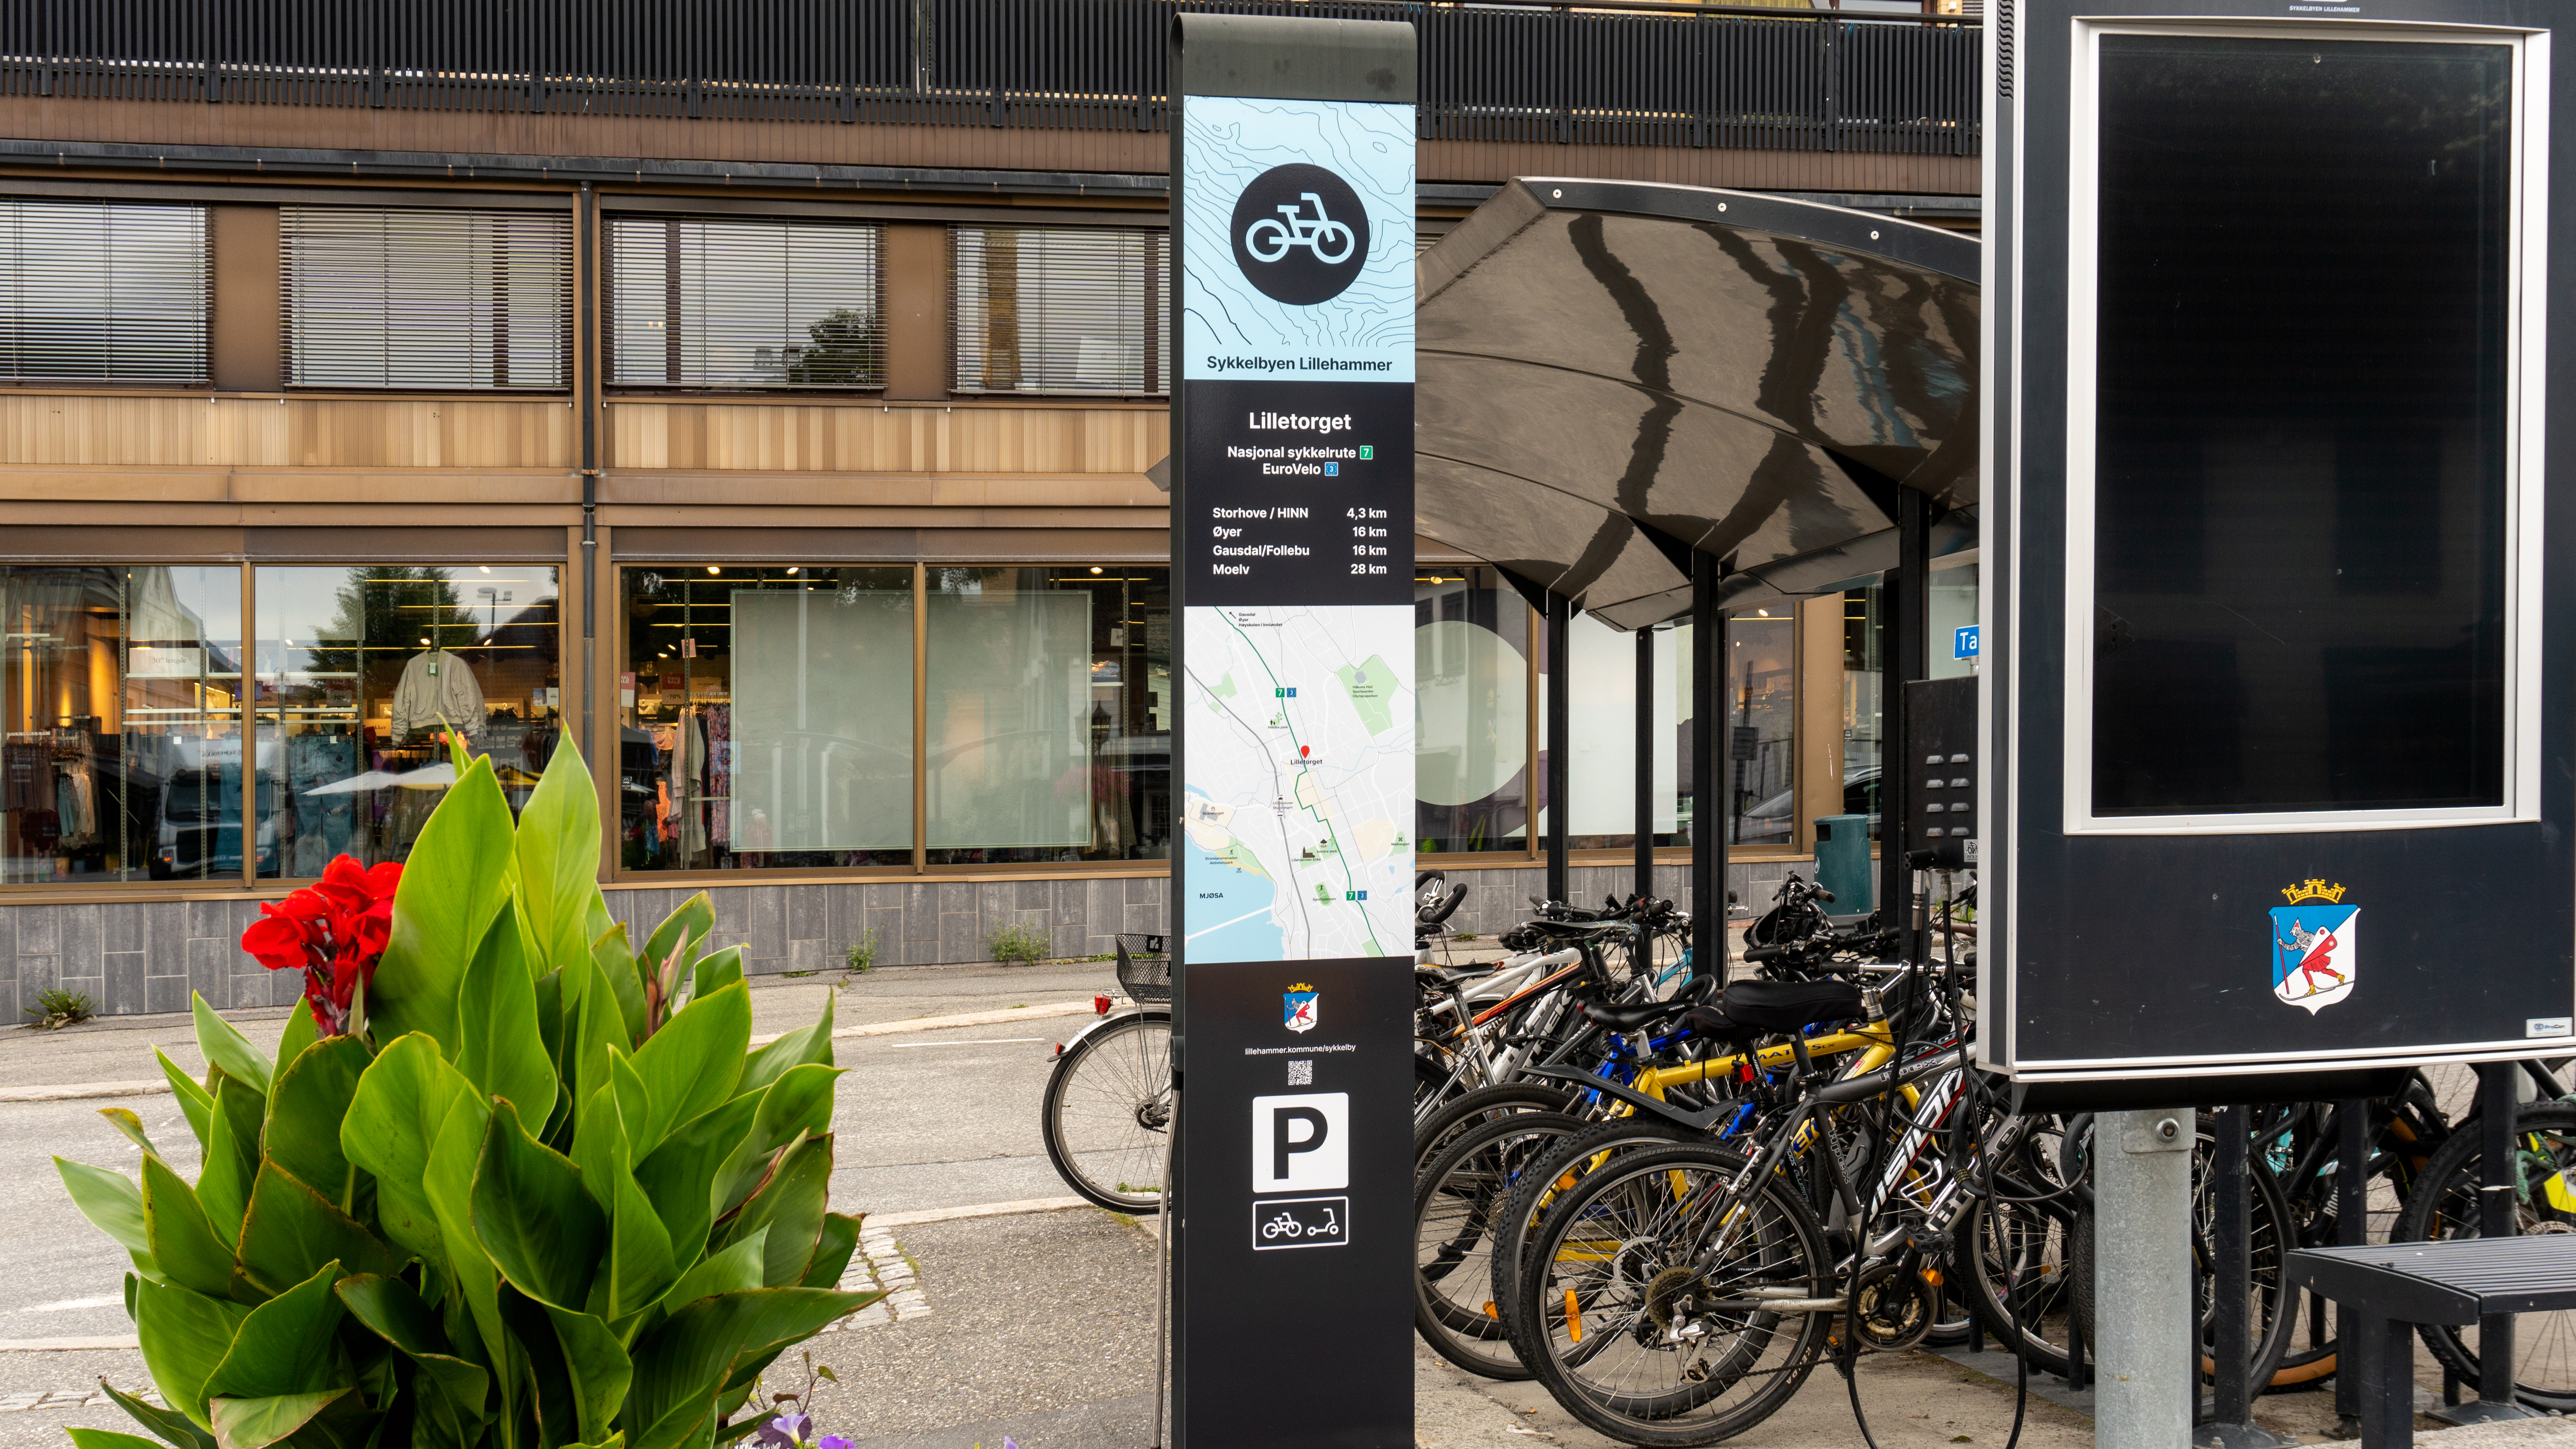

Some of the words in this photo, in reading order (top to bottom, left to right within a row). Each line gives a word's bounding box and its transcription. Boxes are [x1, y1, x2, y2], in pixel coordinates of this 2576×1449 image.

[1207, 356, 1295, 372] Sykkelbyen
[1300, 357, 1392, 371] Lillehammer
[1249, 412, 1351, 433] Lilletorget
[1228, 446, 1284, 460] Nasjonal
[1288, 447, 1356, 460] sykkelrute
[1363, 448, 1369, 457] 7
[1263, 464, 1321, 475] EuroVelo
[1213, 508, 1267, 518] Storhove
[1270, 507, 1275, 519] /
[1278, 508, 1308, 518] HINN
[1347, 508, 1366, 519] 4,3
[1369, 508, 1387, 518] km
[1213, 526, 1242, 539] Øyer
[1353, 527, 1366, 537] 16
[1369, 526, 1387, 537] km
[1213, 545, 1309, 557] Gausdal/Follebu
[1353, 546, 1366, 555] 16
[1369, 545, 1387, 555] km
[1213, 564, 1249, 574] Moelv
[1351, 564, 1366, 574] 28
[1369, 564, 1387, 574] km
[1245, 1043, 1356, 1055] lillehammer.kommune/sykkelby
[1273, 1106, 1328, 1179] P
[1722, 1213, 1741, 1242] Breeze
